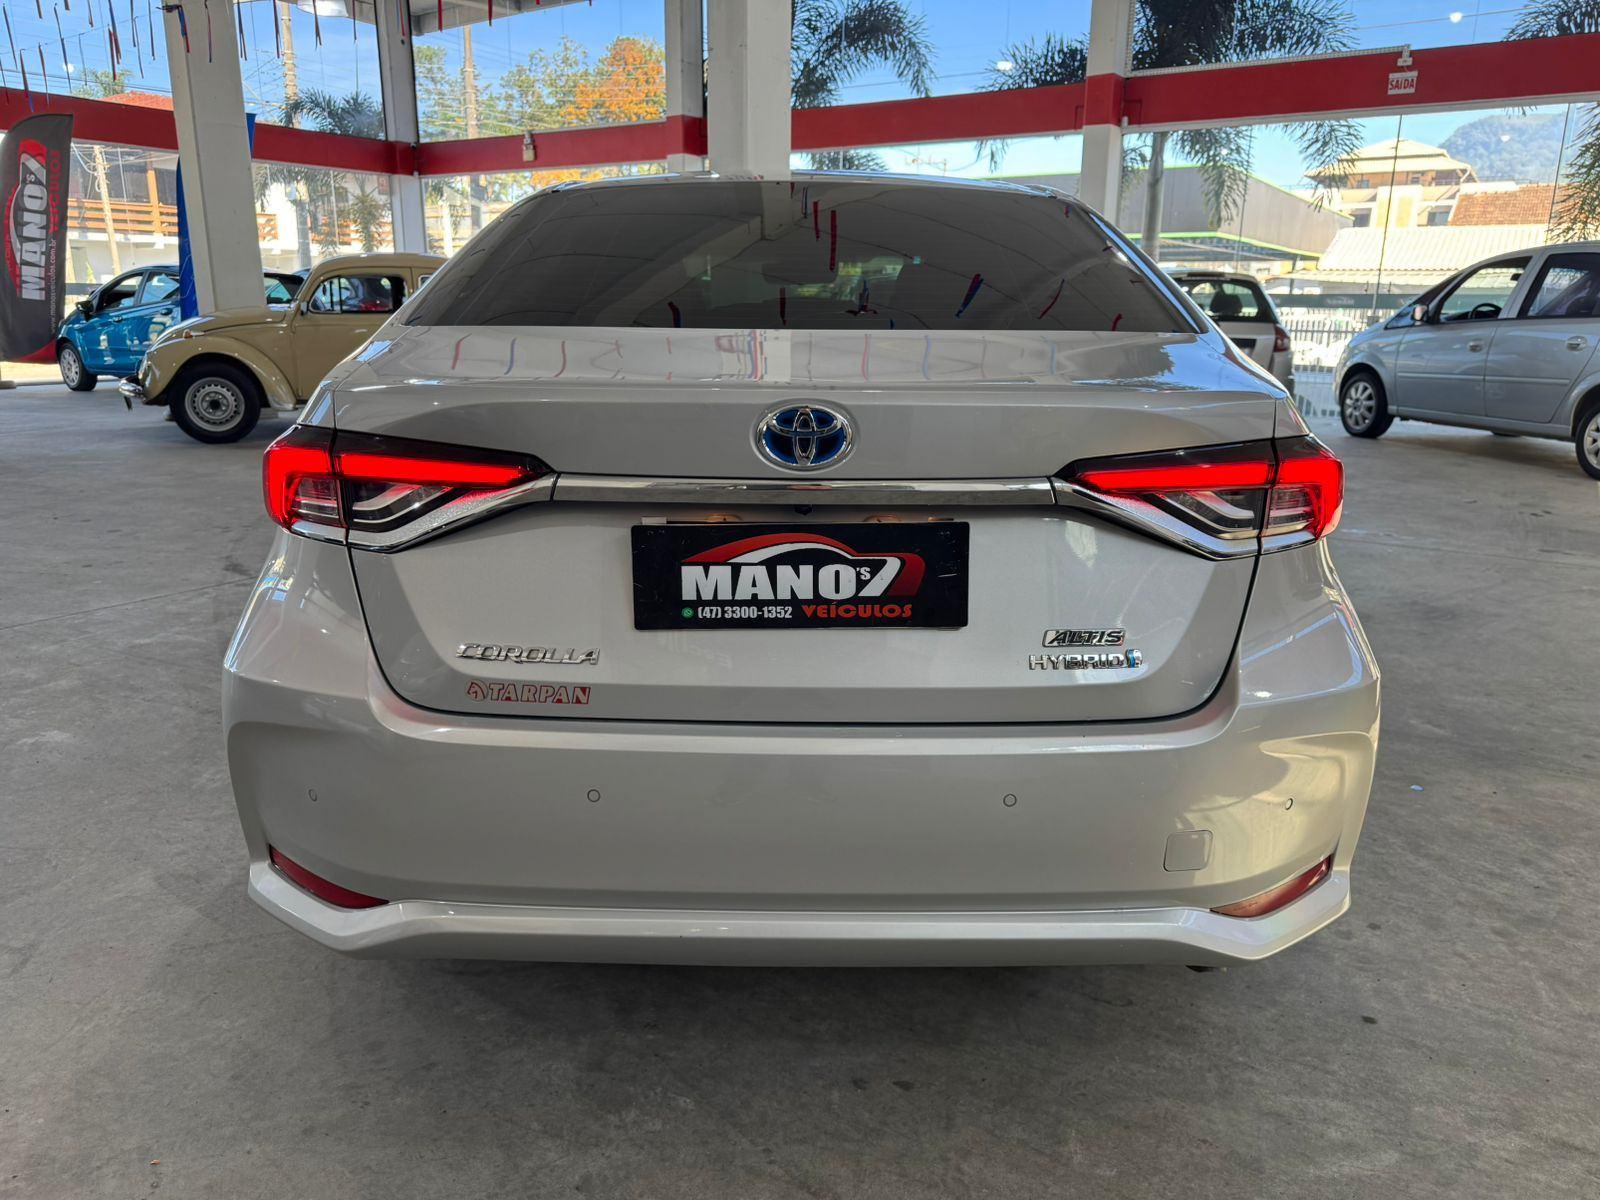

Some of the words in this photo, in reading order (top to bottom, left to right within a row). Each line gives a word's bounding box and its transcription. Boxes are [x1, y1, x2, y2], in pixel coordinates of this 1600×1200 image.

[697, 606, 722, 619] (47)
[724, 606, 793, 619] 3300-1352
[801, 601, 912, 618] VEÍCULOS
[1047, 630, 1123, 645] ALTIS
[456, 643, 600, 665] COROLLA
[1028, 653, 1125, 670] HYBRID
[489, 682, 591, 705] TARPAN
